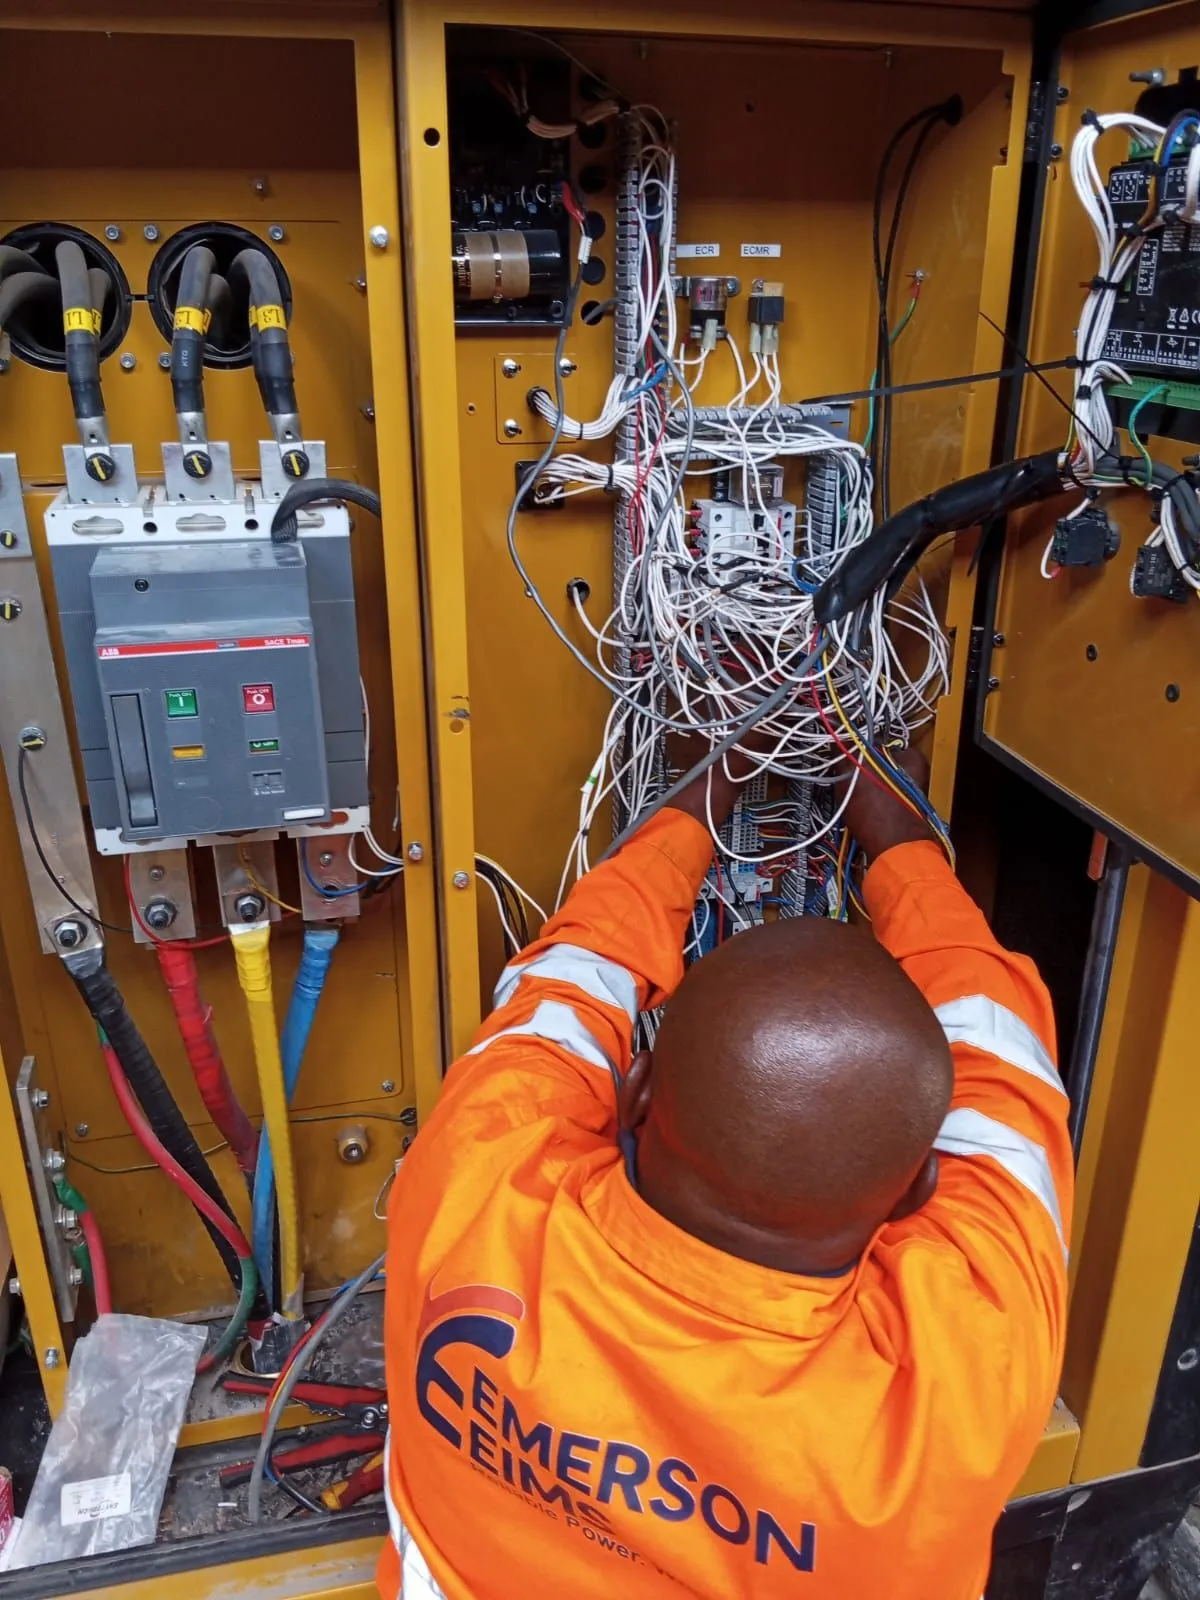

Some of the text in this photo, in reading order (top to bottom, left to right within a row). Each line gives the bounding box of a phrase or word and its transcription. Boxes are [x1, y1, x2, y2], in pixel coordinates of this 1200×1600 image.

[695, 245, 715, 255] ECR
[743, 245, 770, 255] ECMR
[262, 307, 282, 324] L3
[263, 638, 285, 646] SACE
[101, 647, 120, 656] ABB
[472, 1364, 816, 1573] EMERSON
[469, 1418, 617, 1536] EIMS
